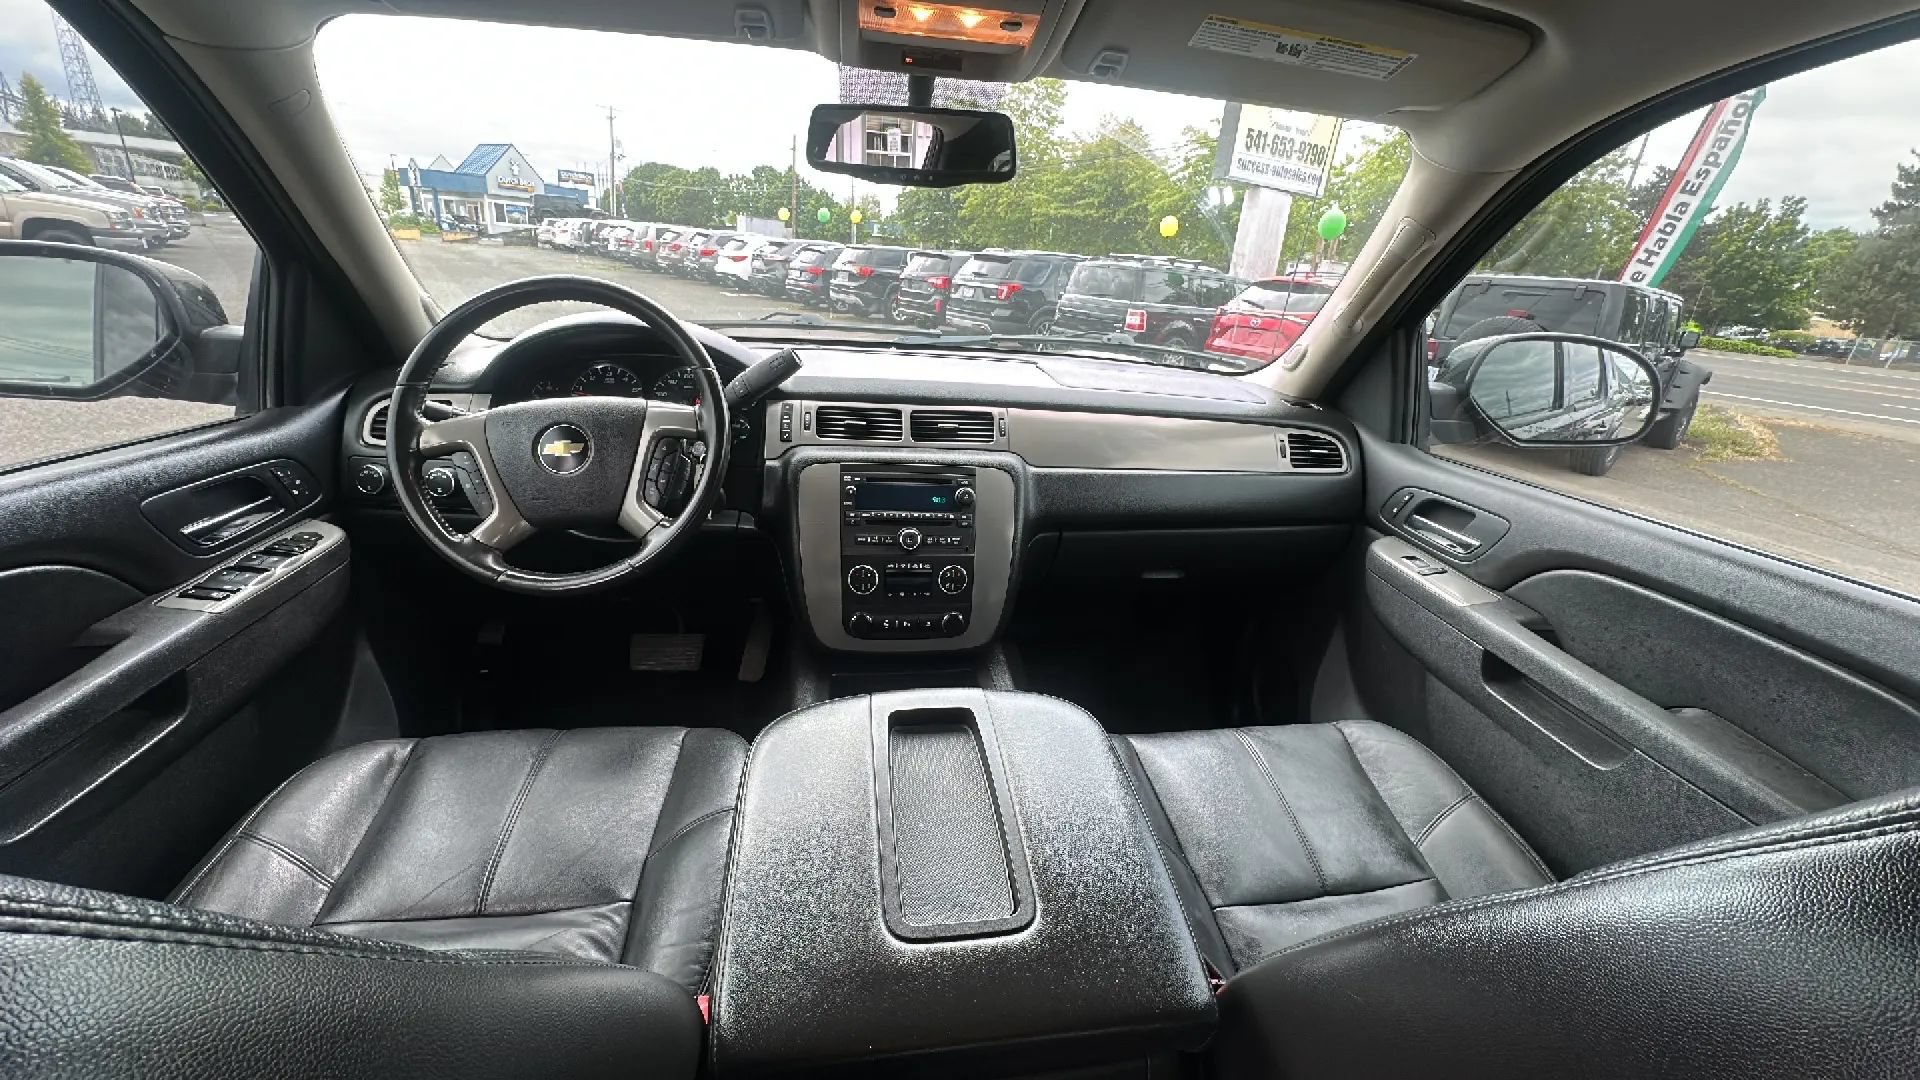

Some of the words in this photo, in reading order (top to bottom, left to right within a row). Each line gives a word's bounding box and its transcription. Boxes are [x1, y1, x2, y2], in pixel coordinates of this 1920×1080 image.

[1681, 94, 1754, 196] Español
[1637, 202, 1690, 266] Habla
[1629, 271, 1647, 283] e
